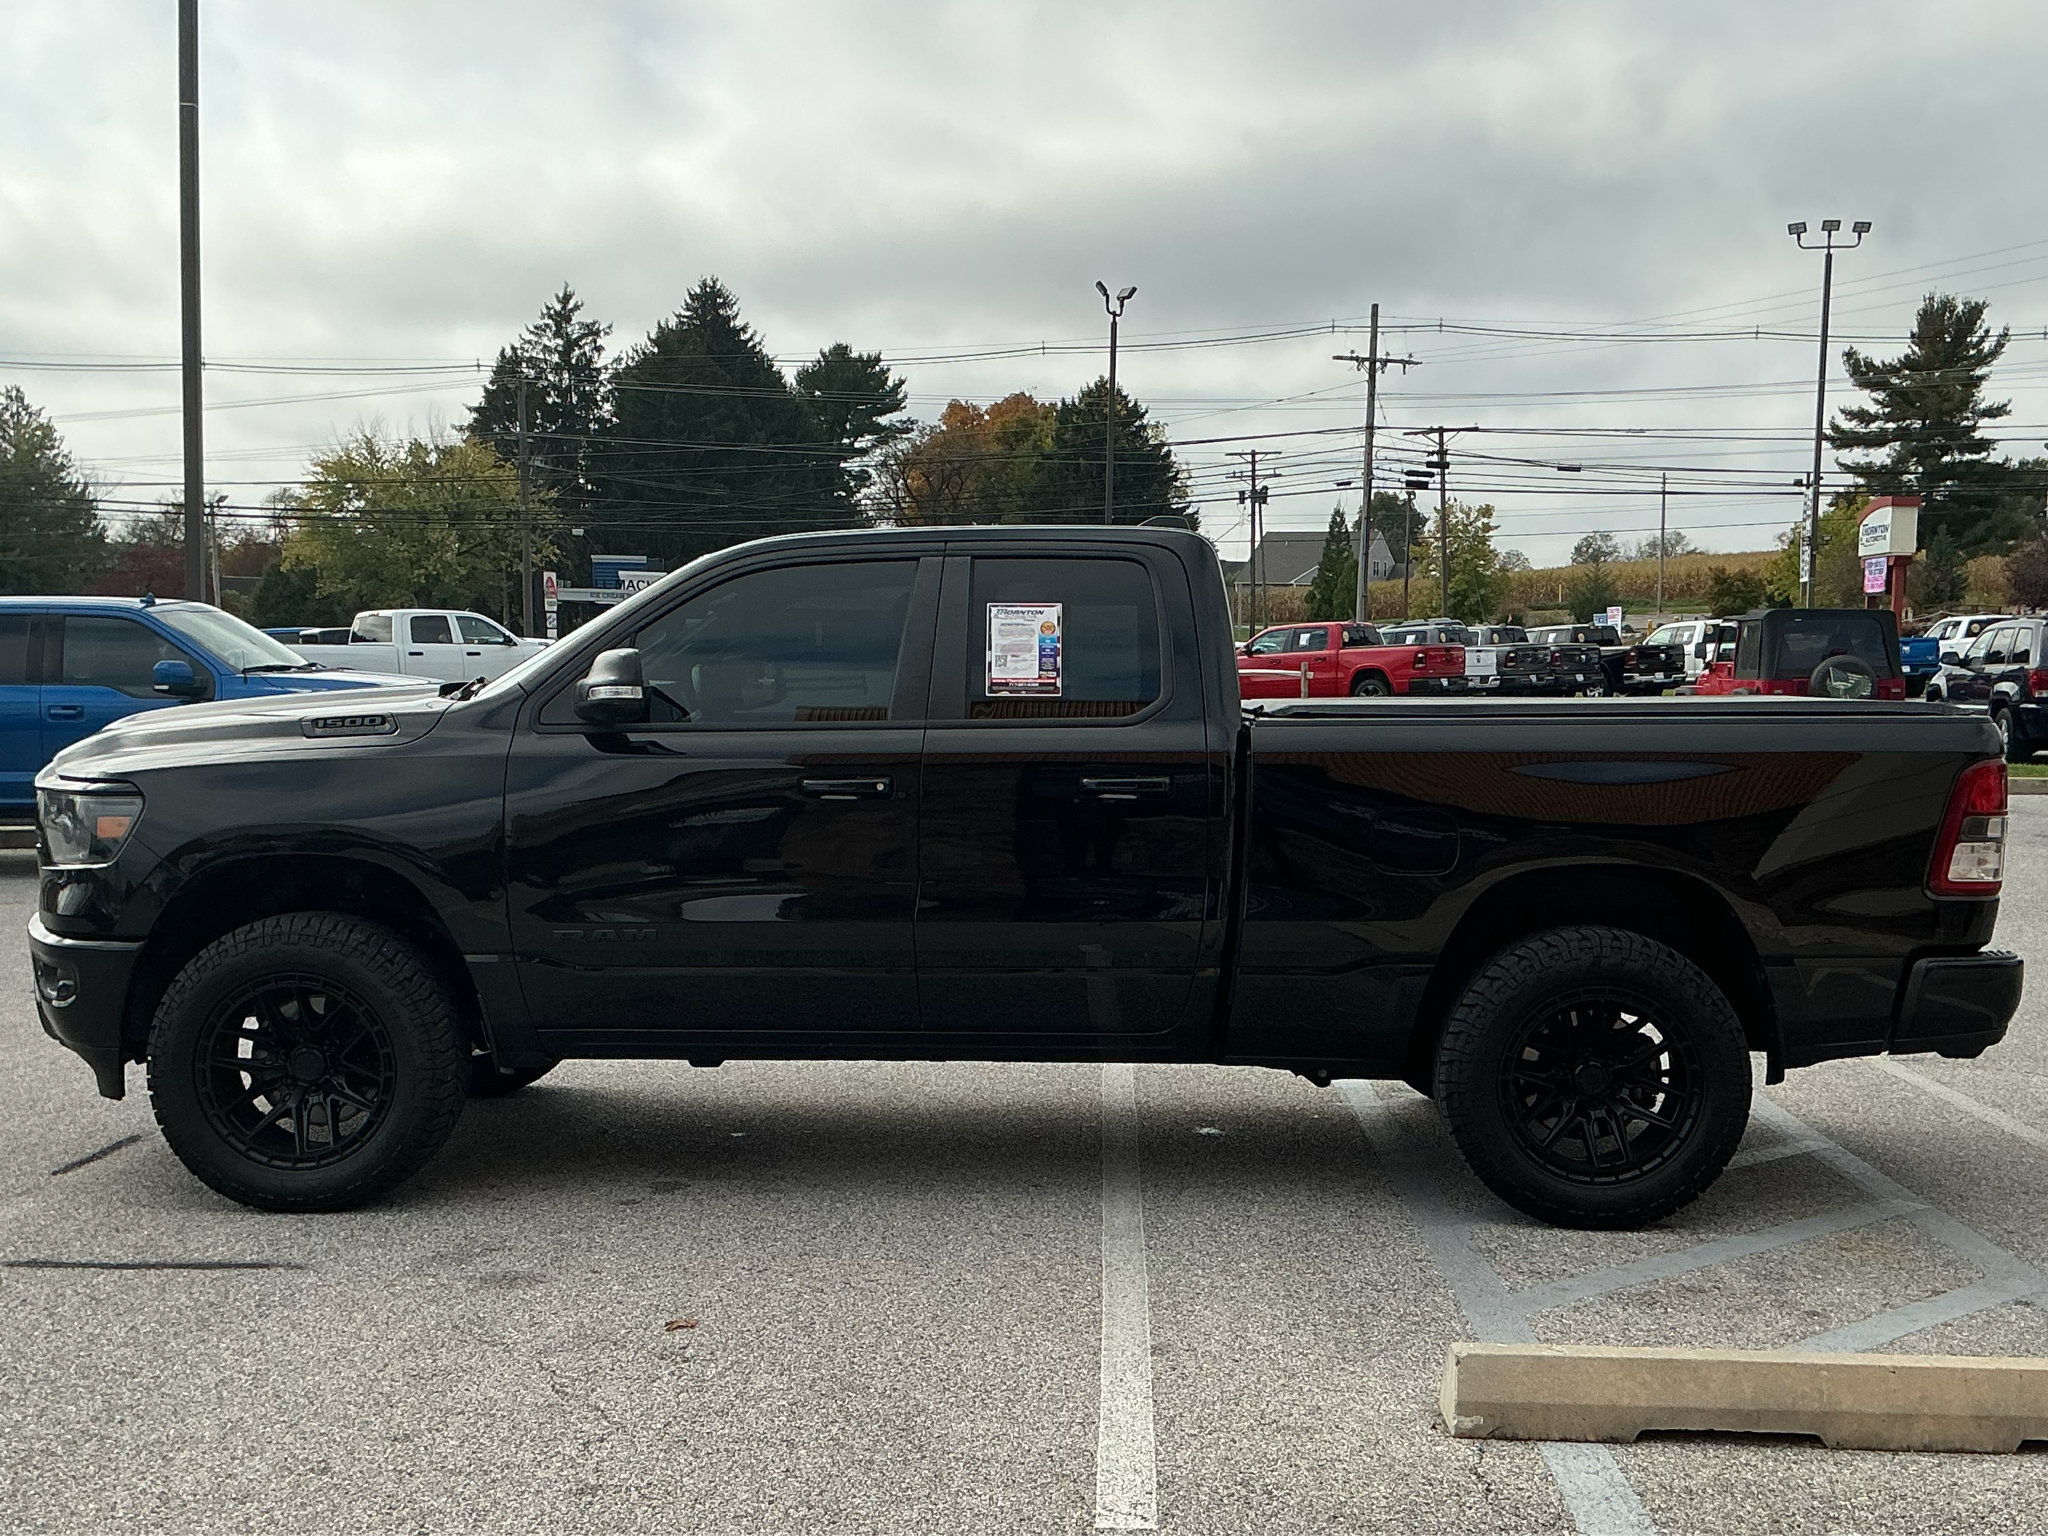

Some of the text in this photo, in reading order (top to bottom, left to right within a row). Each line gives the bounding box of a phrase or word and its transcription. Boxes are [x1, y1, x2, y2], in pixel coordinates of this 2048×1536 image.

[996, 608, 1045, 616] THORNTON
[313, 716, 382, 728] 1500
[551, 928, 658, 943] RAM
